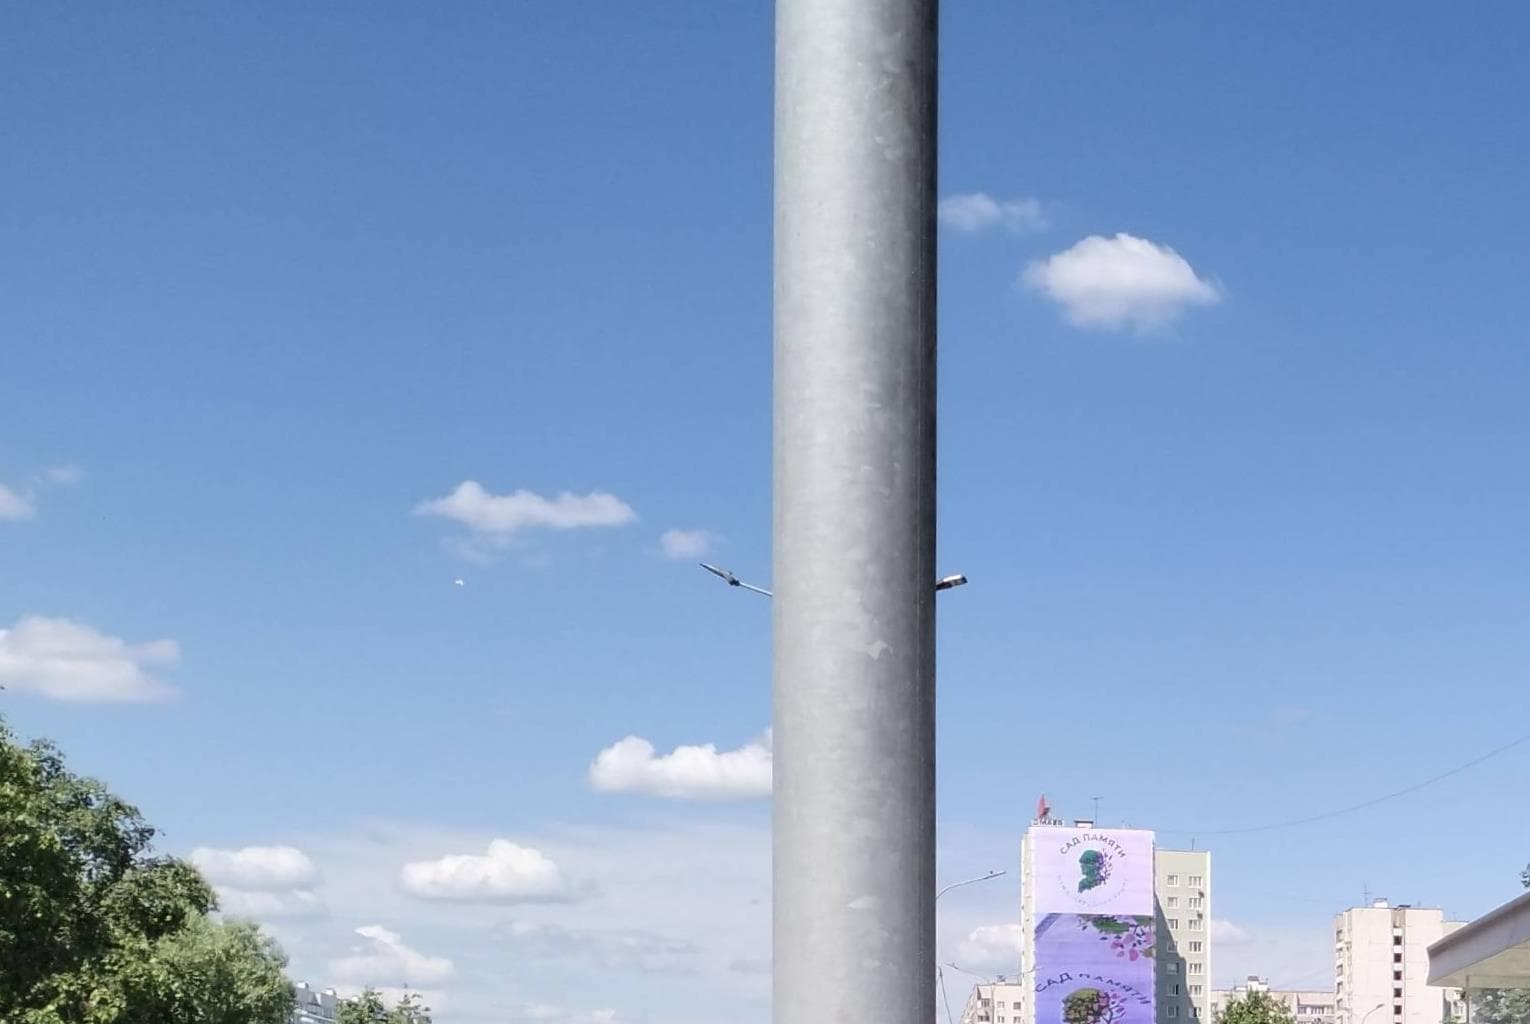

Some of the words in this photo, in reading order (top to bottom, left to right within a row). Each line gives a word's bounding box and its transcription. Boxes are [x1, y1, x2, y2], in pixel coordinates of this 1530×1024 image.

[1060, 836, 1081, 855] САД
[1082, 833, 1127, 859] ПАМЯТИ
[1035, 972, 1073, 993] САД
